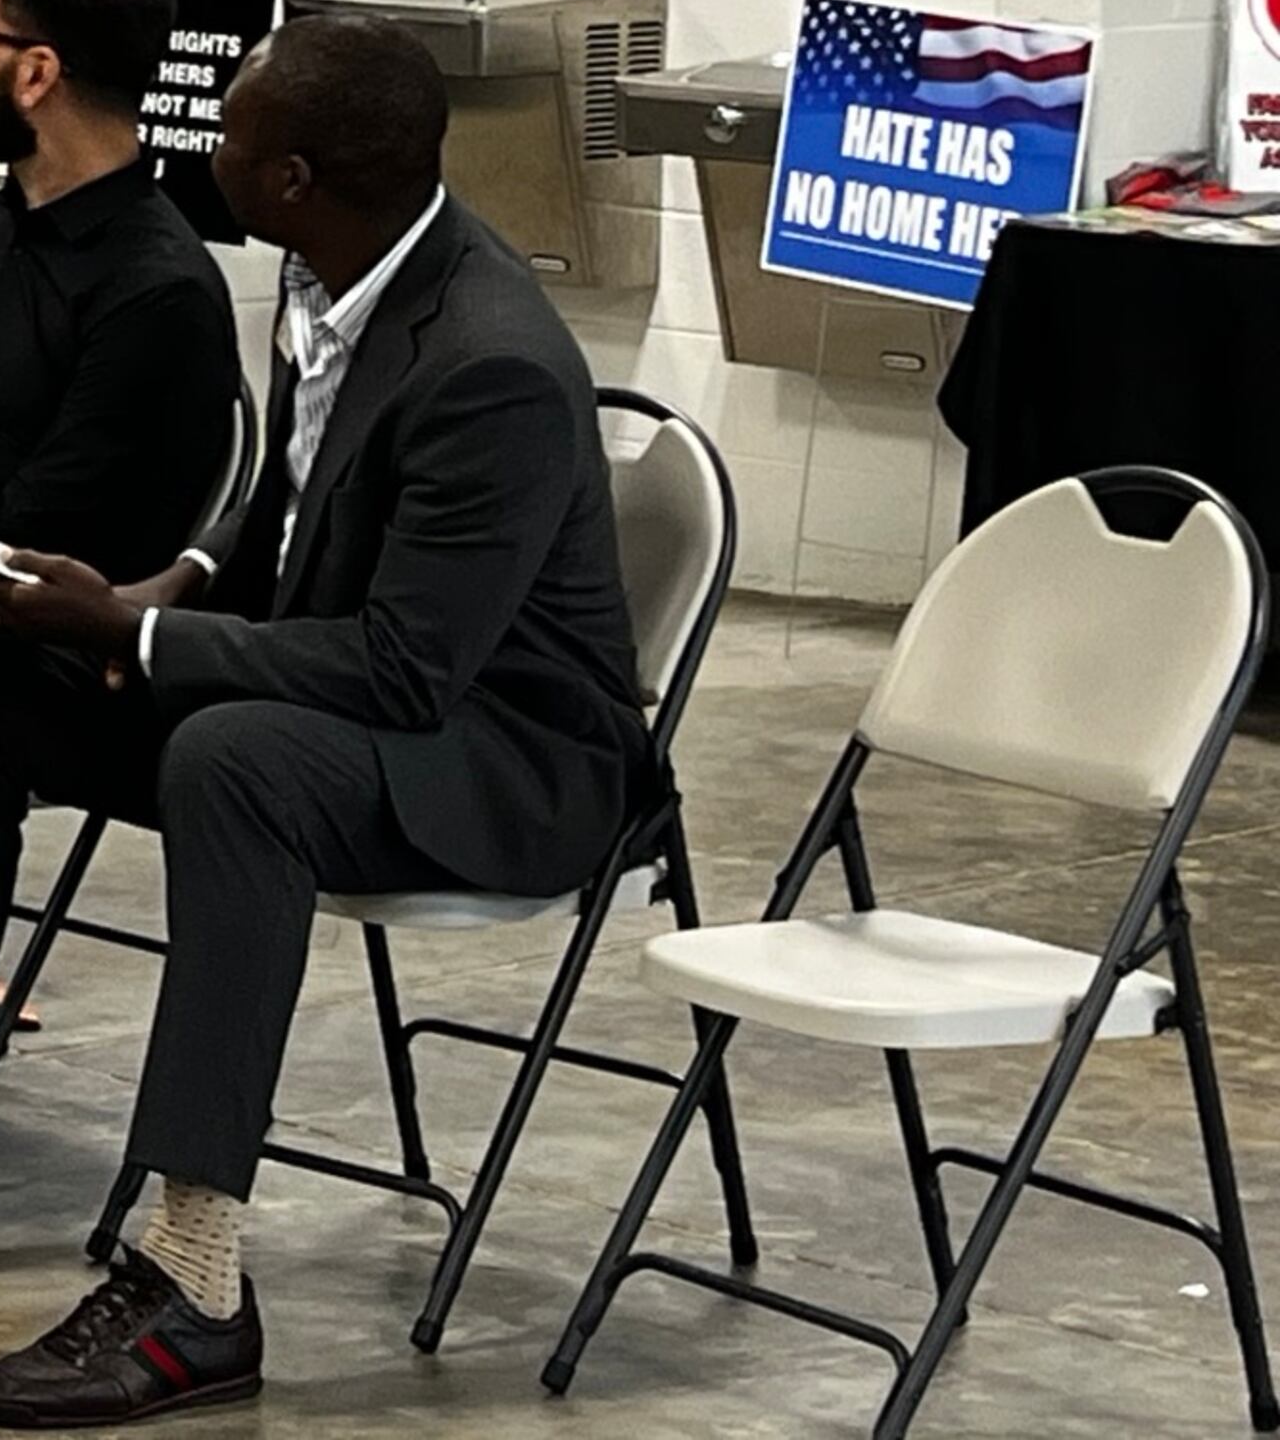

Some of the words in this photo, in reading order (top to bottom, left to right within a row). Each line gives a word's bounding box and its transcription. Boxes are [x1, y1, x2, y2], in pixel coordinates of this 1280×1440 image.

[140, 92, 186, 116] NOT
[841, 103, 934, 171] HATE
[934, 119, 1015, 186] HAS
[783, 170, 836, 230] NO
[839, 180, 947, 252] HOME
